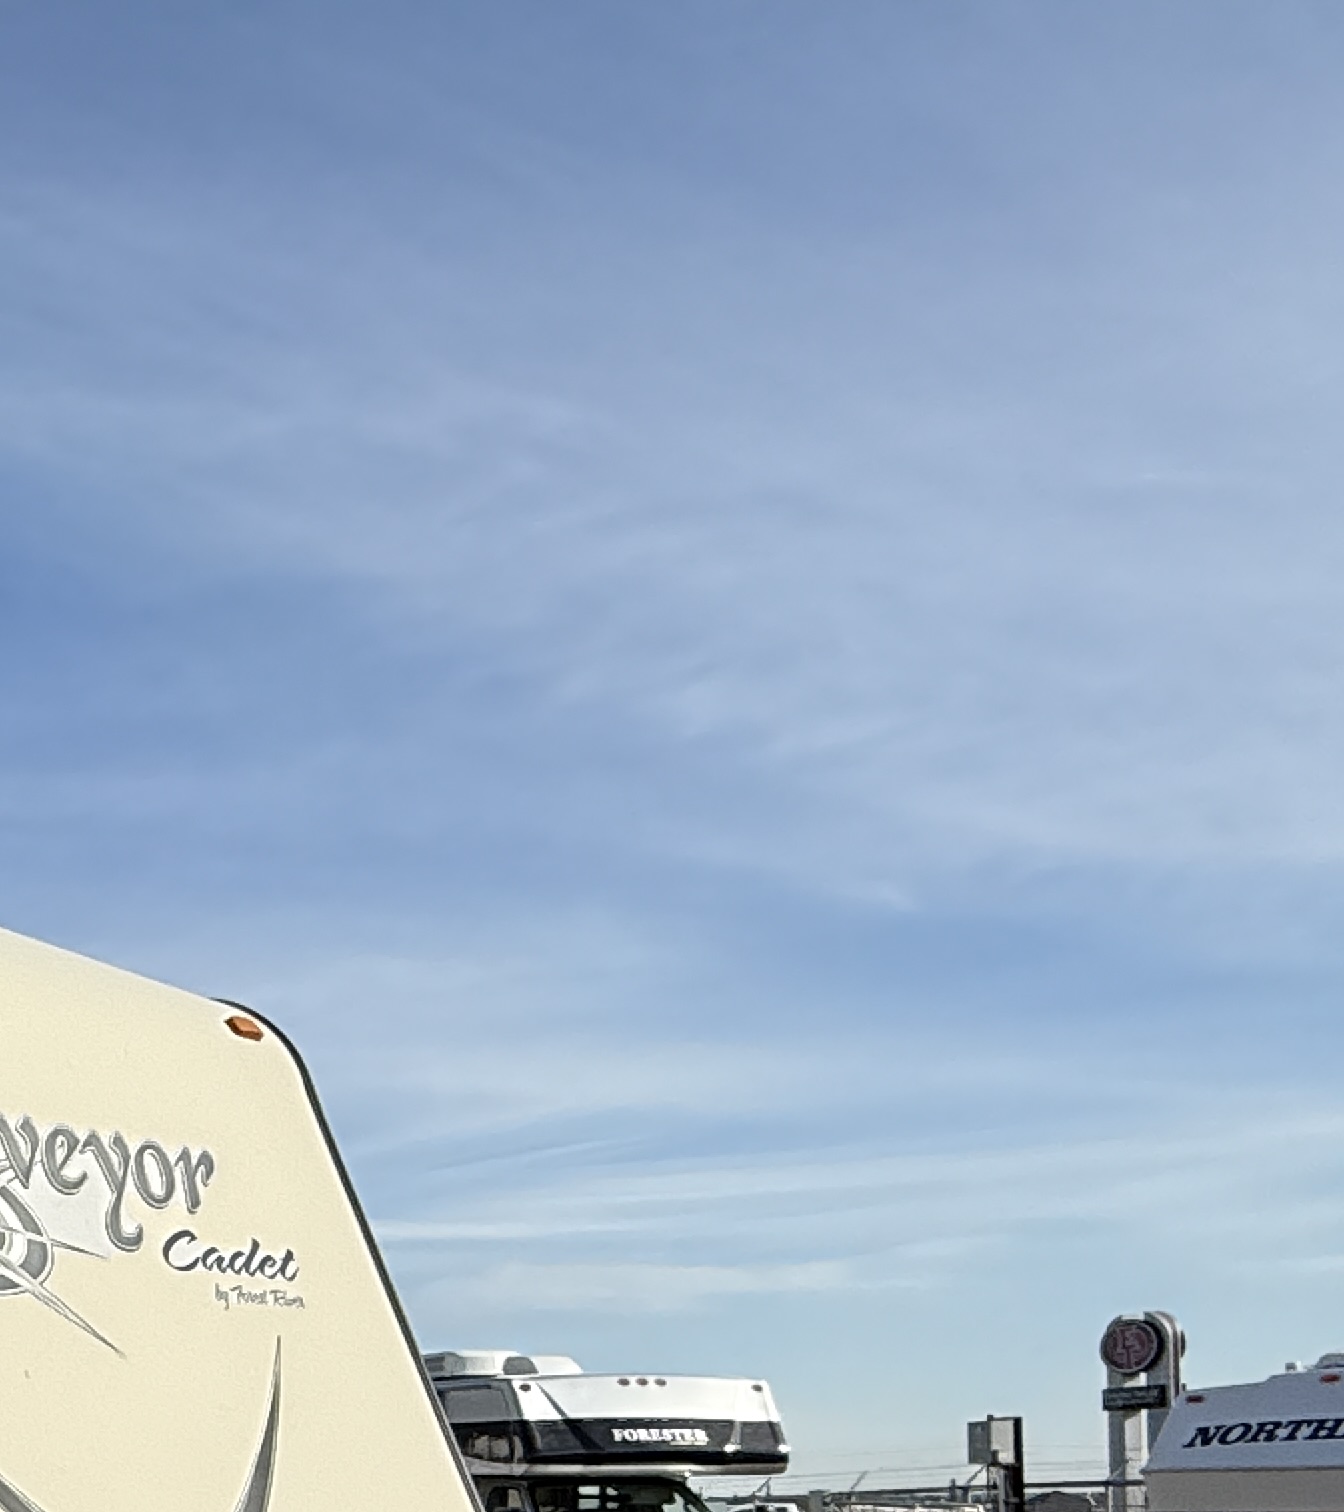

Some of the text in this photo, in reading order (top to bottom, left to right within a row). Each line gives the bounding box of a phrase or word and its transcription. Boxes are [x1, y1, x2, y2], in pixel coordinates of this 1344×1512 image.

[162, 1229, 300, 1282] Cadet
[610, 1427, 710, 1442] FORESTER
[1182, 1418, 1344, 1449] NORTH
